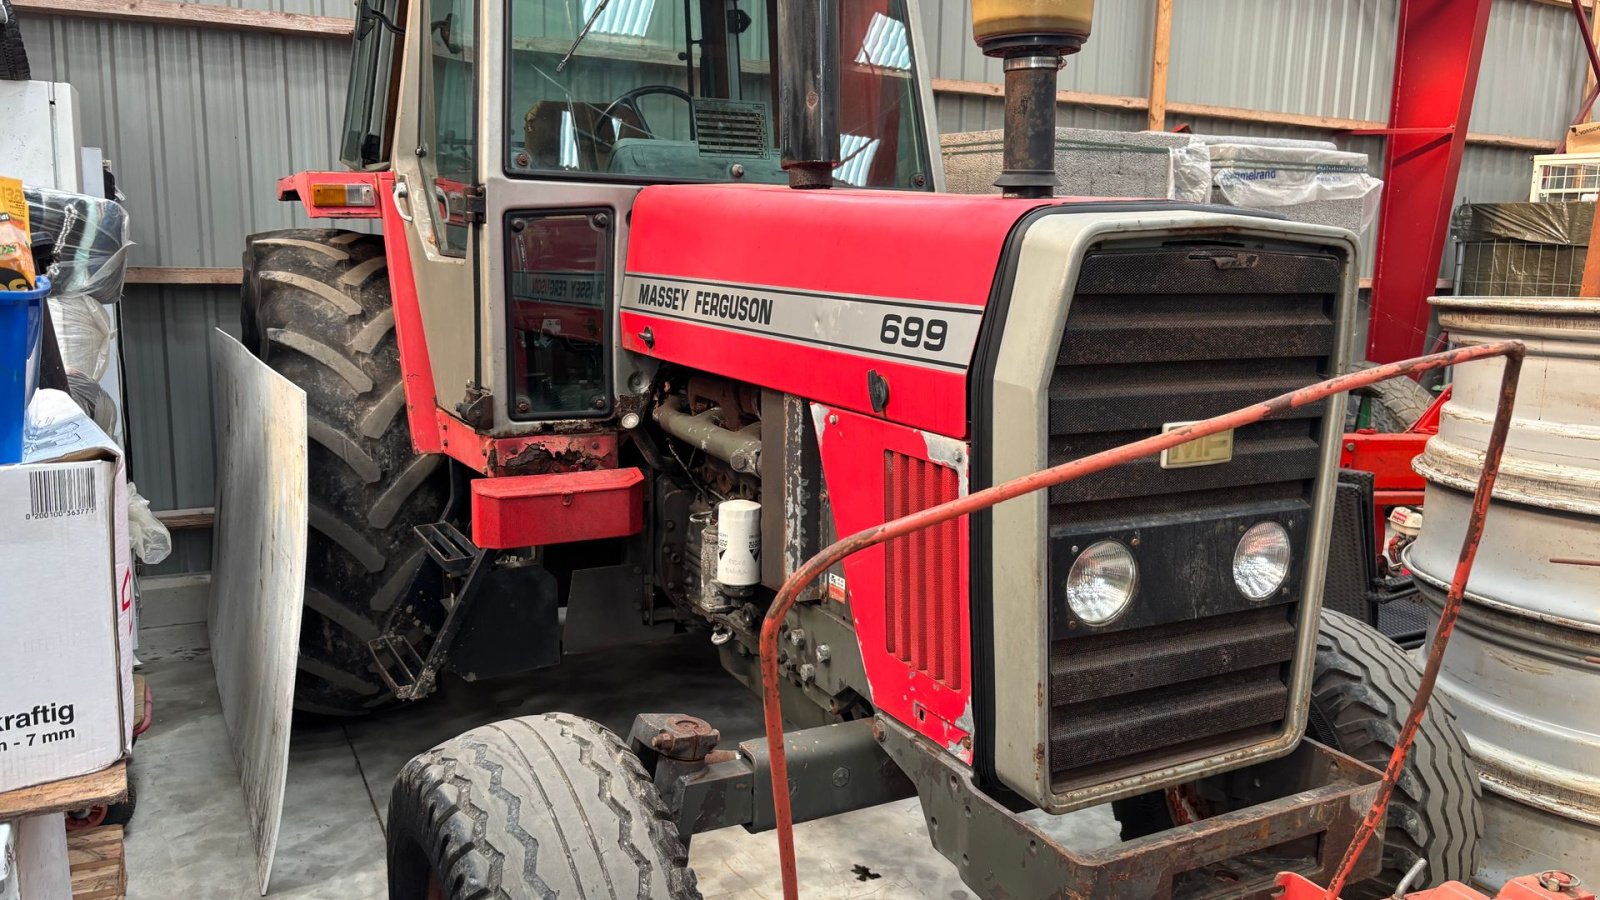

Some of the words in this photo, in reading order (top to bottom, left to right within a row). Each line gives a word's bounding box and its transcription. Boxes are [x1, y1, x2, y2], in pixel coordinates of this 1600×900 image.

[638, 283, 689, 311] MASSEY
[694, 290, 773, 325] FERGUSON
[879, 313, 949, 352] 699
[26, 733, 36, 746] 7
[42, 728, 75, 744] mm
